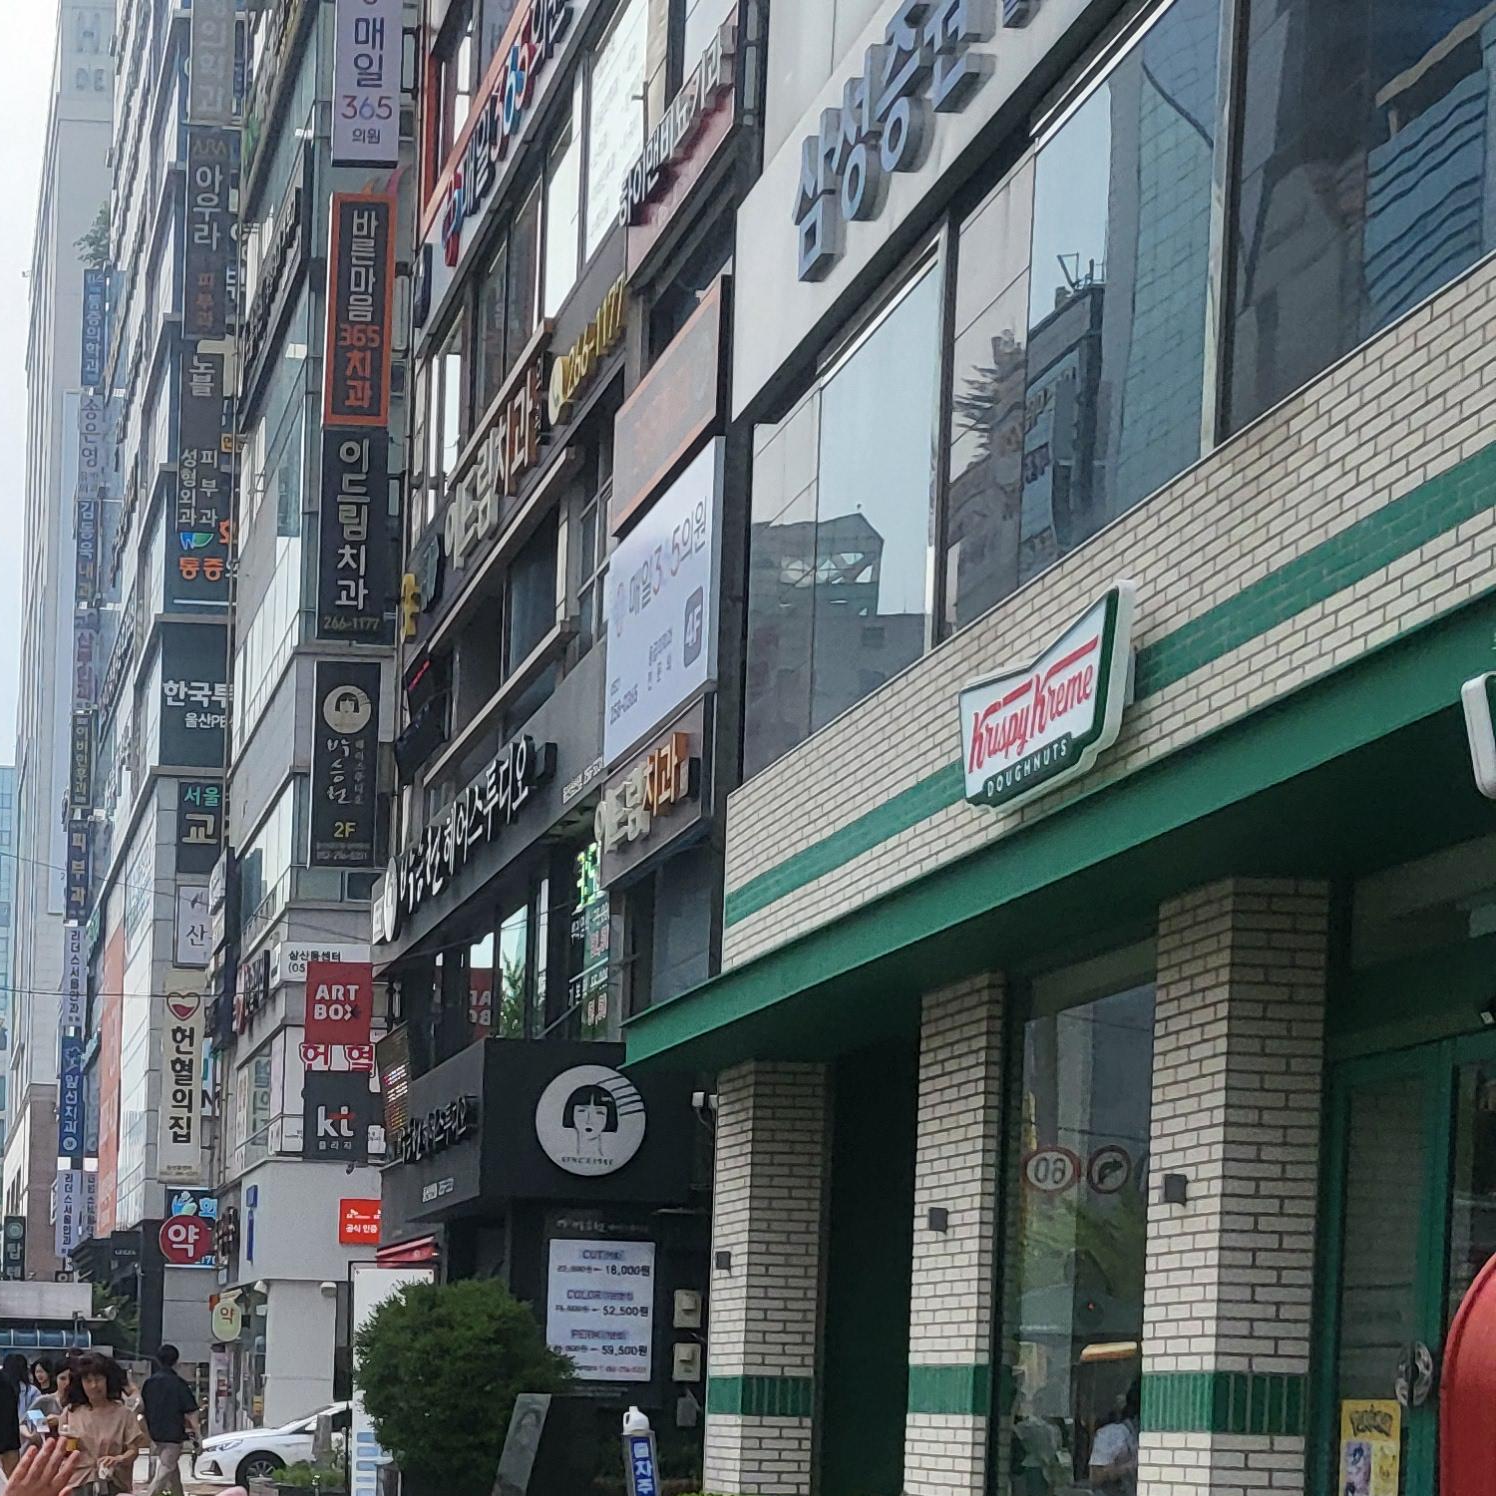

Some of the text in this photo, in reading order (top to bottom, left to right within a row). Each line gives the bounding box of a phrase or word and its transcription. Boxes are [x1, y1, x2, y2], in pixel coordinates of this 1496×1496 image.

[353, 16, 385, 88] 매일
[341, 95, 393, 121] 365
[352, 128, 381, 145] 의원
[348, 209, 379, 322] 바른마음
[339, 325, 381, 348] 365
[345, 350, 374, 409] 치과
[336, 437, 371, 611] 이드림치과
[322, 615, 381, 632] 266-1177
[968, 634, 1100, 774] Krispy Kreme
[987, 739, 1068, 797] DOUGHNUTS
[183, 786, 219, 806] 서울
[333, 821, 357, 838] 2F
[315, 984, 360, 1001] ART
[314, 1003, 361, 1020] BOX
[168, 1025, 196, 1145] 헌혈의집
[167, 1224, 200, 1258] 약
[220, 1306, 235, 1325] 약
